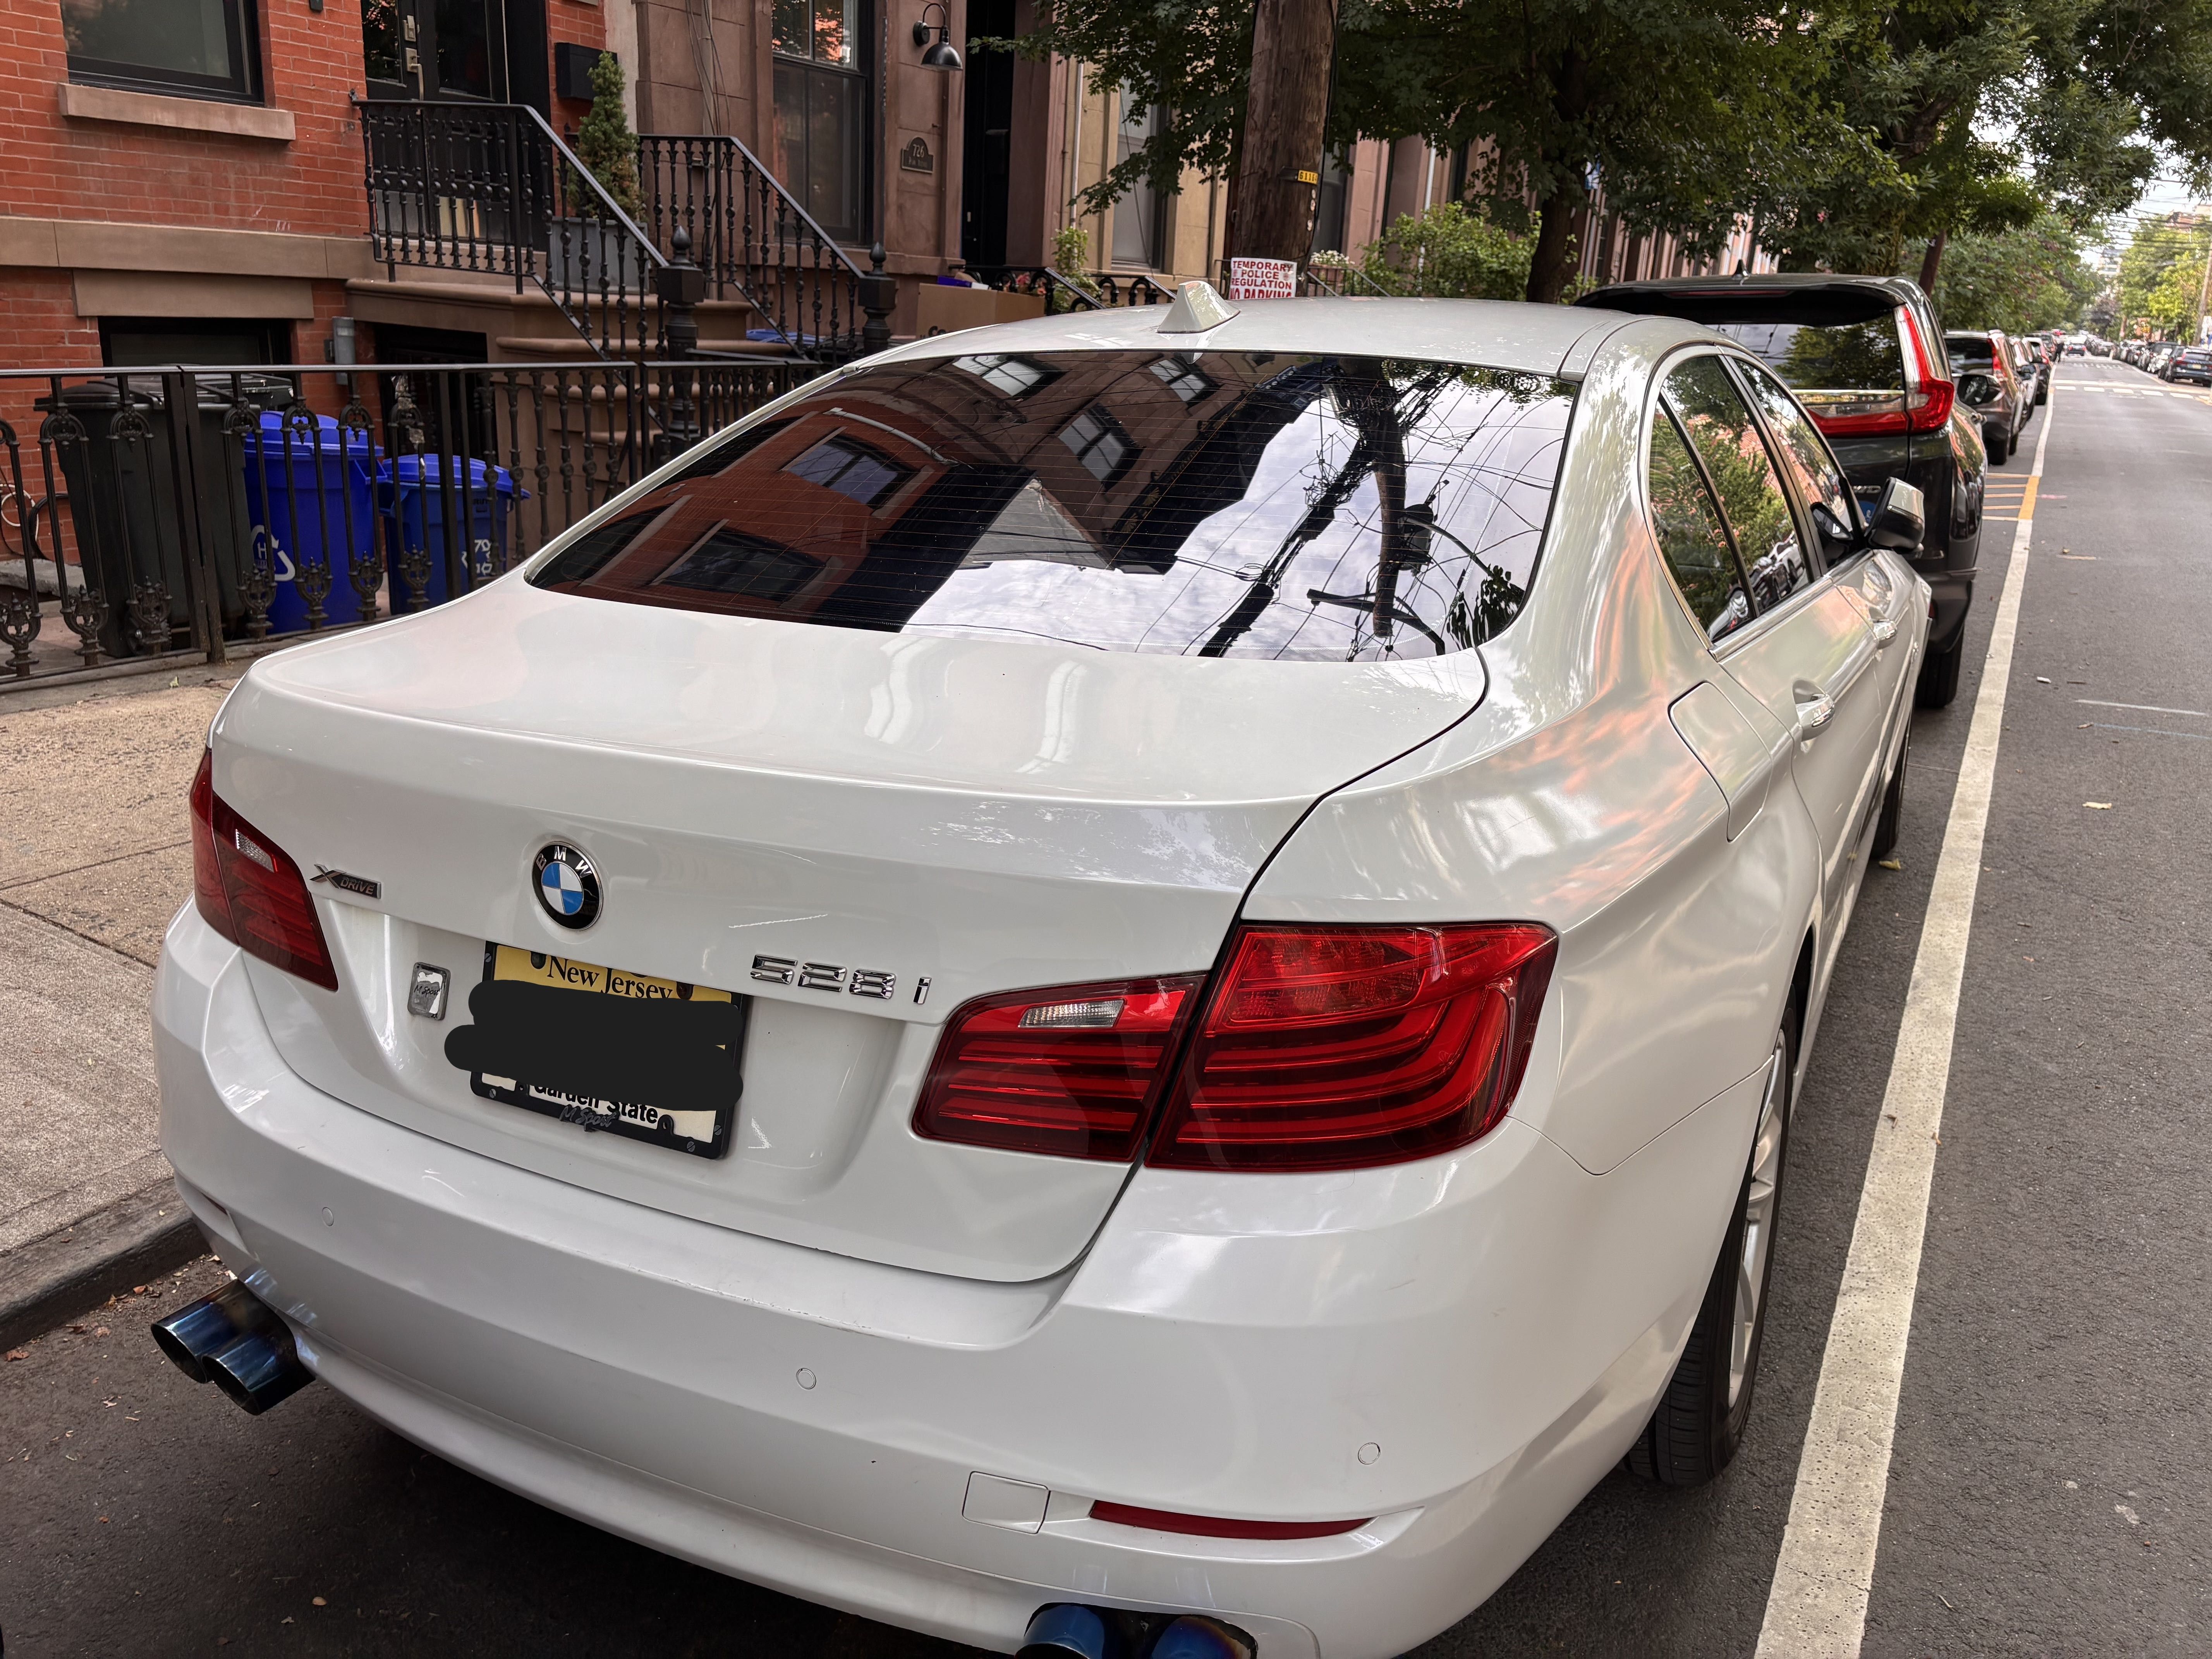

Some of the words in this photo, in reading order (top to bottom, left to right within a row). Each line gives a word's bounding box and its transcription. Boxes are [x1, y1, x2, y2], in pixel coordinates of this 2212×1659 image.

[1233, 261, 1292, 272] TEMPORARY
[1241, 270, 1279, 280] POLICE
[1231, 278, 1291, 290] REGULATION
[1230, 288, 1240, 299] NO
[536, 846, 592, 878] BMW
[547, 955, 599, 987] New
[601, 968, 673, 998] Jersey
[414, 985, 422, 993] M
[607, 1101, 658, 1123] State
